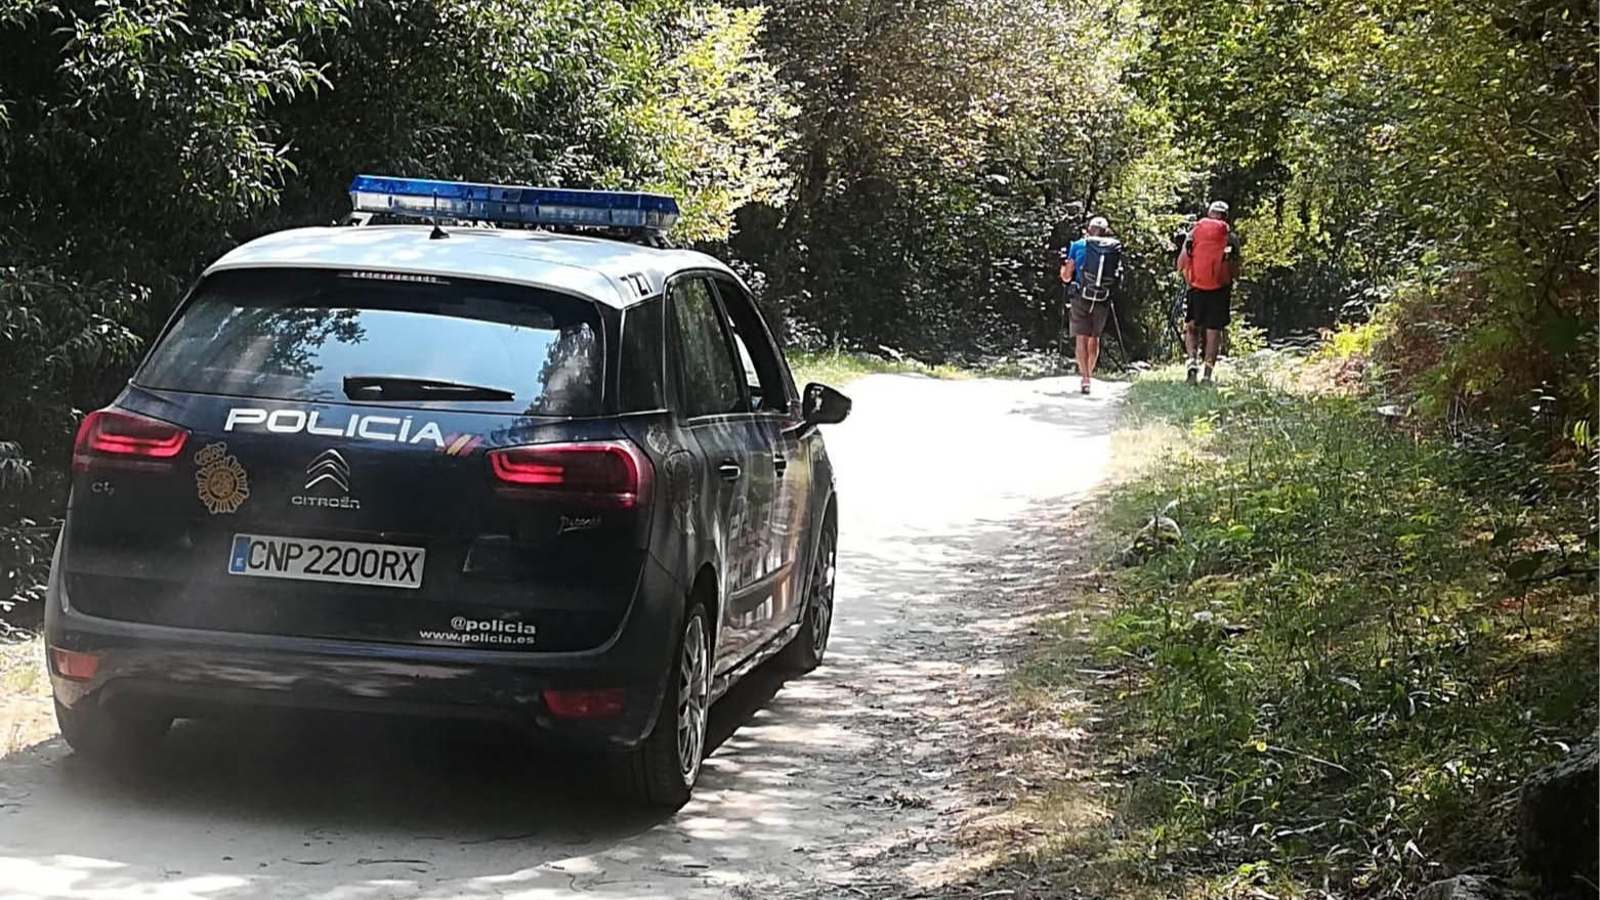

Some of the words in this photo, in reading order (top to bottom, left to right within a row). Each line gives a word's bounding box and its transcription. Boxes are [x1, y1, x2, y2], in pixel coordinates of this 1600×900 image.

[223, 406, 446, 447] POLICÍA
[247, 540, 420, 583] CNP2200RX
[419, 630, 536, 645] www.policia.es
[450, 615, 537, 635] @policia
